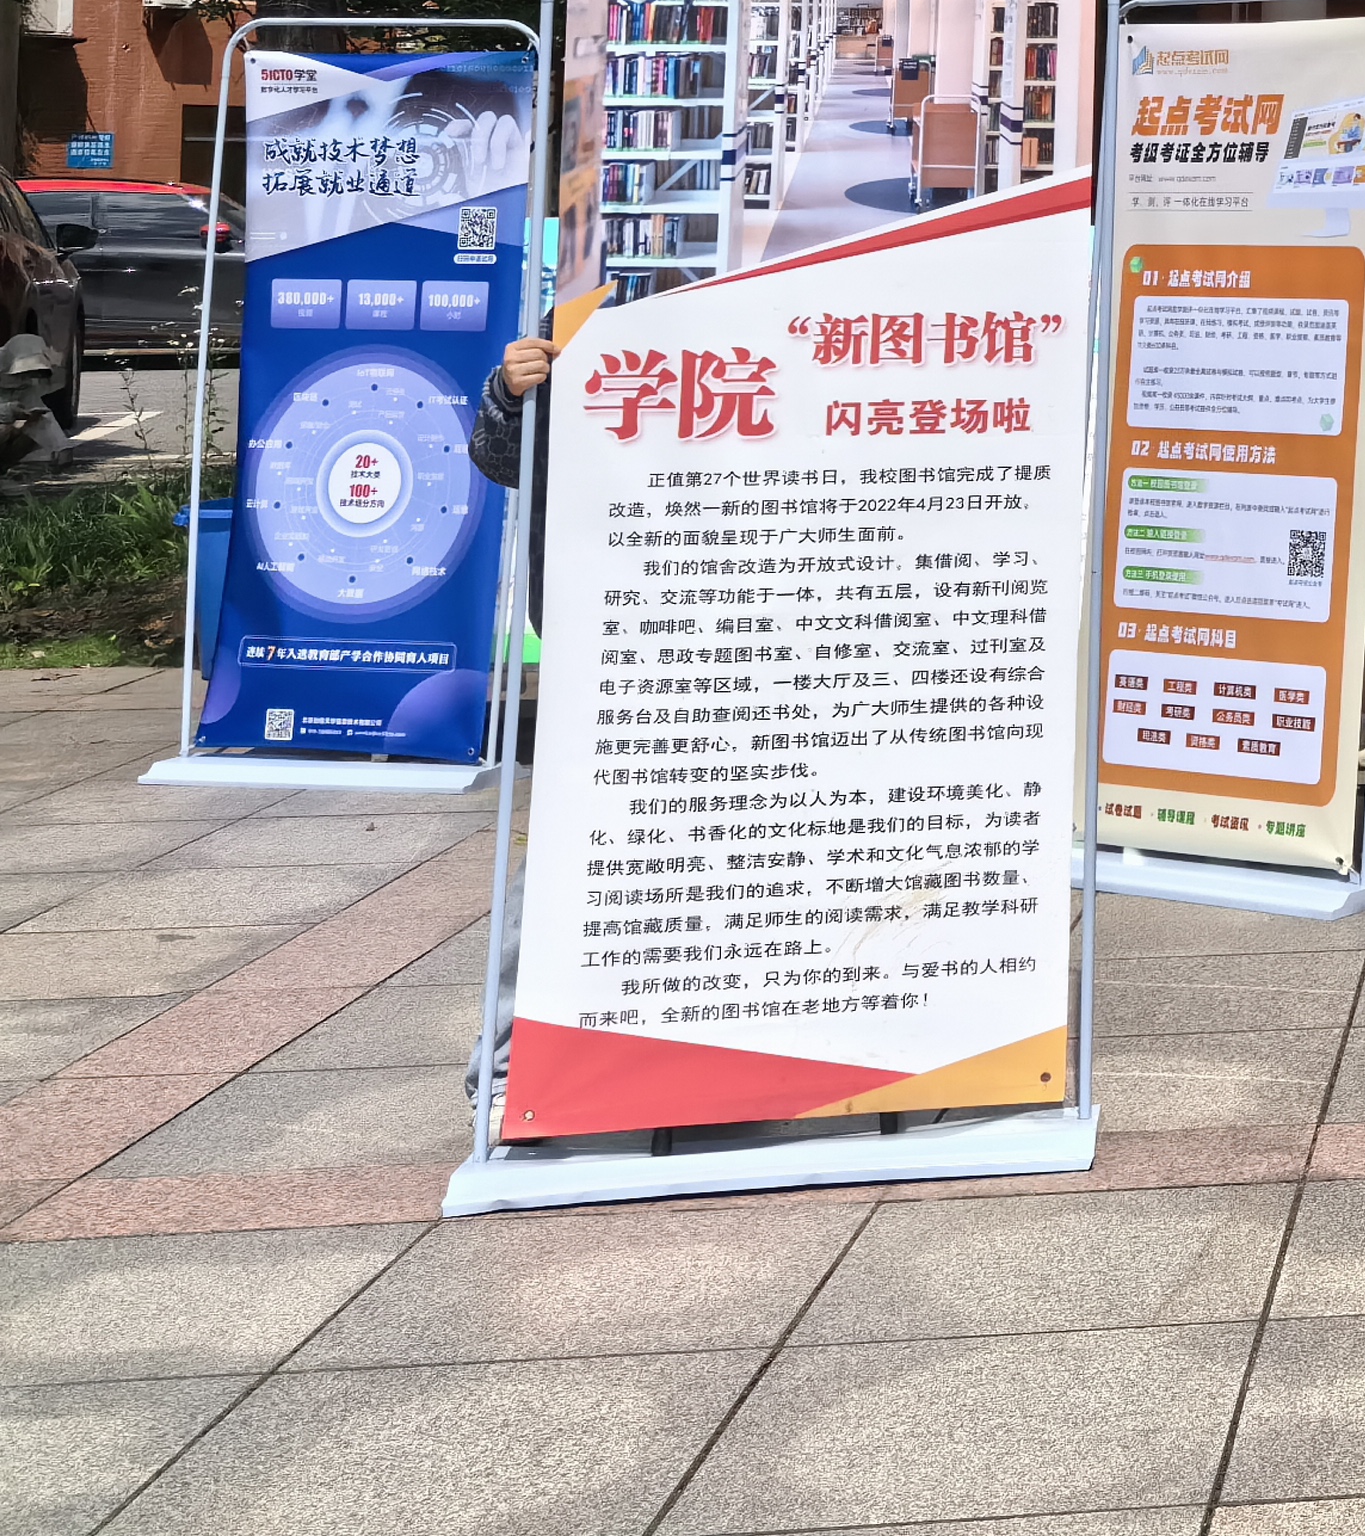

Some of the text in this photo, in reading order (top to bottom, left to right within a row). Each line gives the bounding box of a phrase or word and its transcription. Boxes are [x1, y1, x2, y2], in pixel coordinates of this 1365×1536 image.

[1156, 50, 1229, 66] 起点考试网
[1131, 94, 1285, 136] 起点考试网
[264, 137, 420, 167] 成就技术梦想
[1130, 142, 1270, 164] 考级考证全方位辅导
[263, 170, 420, 197] 拓展就业通道
[358, 294, 404, 307] 13,000+
[428, 294, 481, 308] 100,000+
[787, 311, 1063, 366] “新图书馆”
[583, 347, 776, 440] 学院
[825, 399, 1032, 436] 闪亮登场啦
[355, 455, 378, 468] 20+
[350, 484, 378, 498] 100+
[1167, 682, 1192, 694] 工程类
[1218, 686, 1252, 698] 计算机类
[1278, 691, 1305, 703] 医学类
[1217, 712, 1252, 724] 公务员类
[1242, 740, 1278, 754] 素质教育
[1266, 820, 1306, 838] 专题讲座
